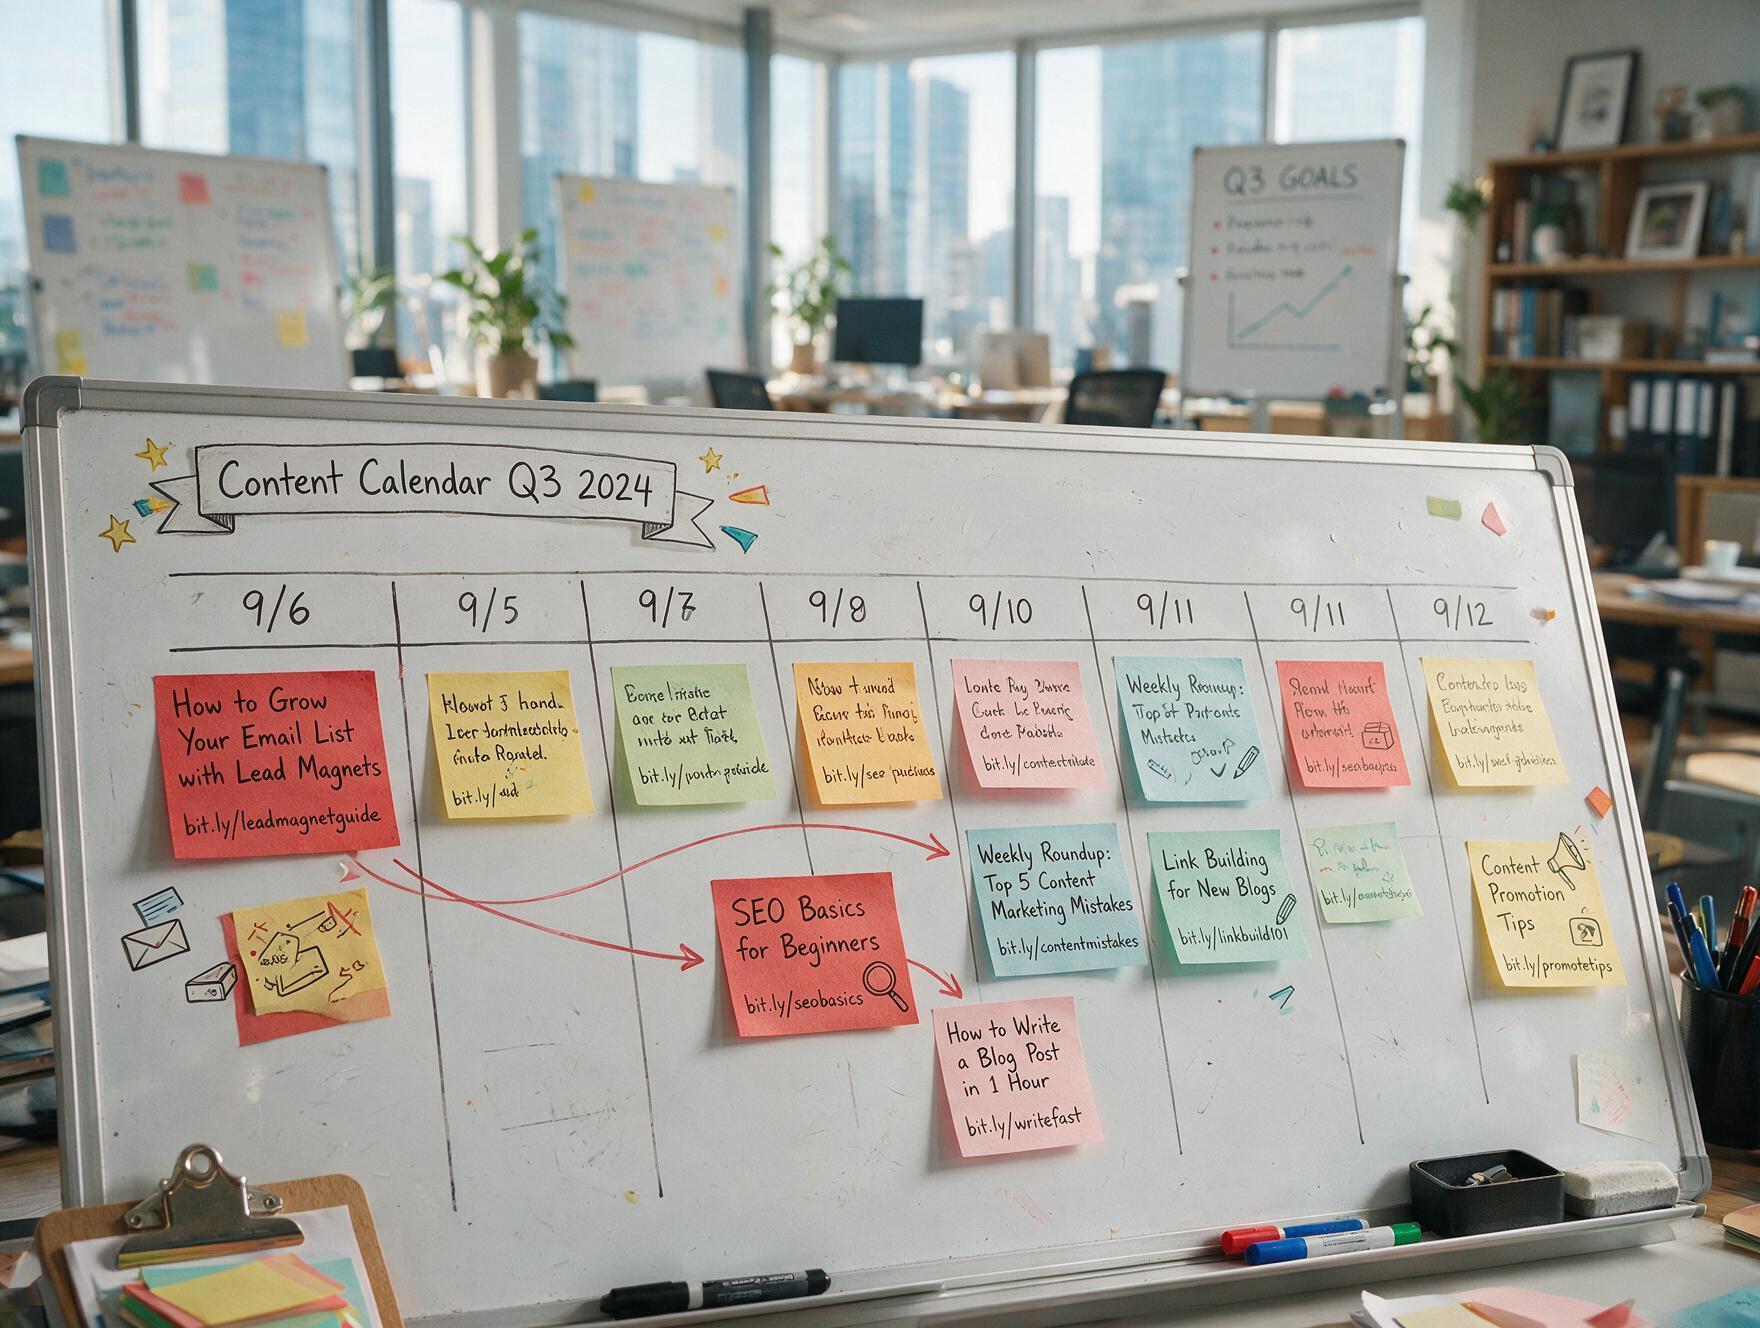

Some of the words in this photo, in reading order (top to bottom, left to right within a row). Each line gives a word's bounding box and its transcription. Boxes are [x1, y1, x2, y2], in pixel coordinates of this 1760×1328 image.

[1223, 164, 1266, 196] Q3
[1278, 163, 1358, 191] GOALS
[218, 459, 344, 499] Content
[359, 458, 491, 496] Calendar
[508, 462, 561, 504] Q3
[579, 469, 653, 507] 2024
[243, 584, 310, 633] 9/6
[458, 586, 519, 633] 9/5
[969, 590, 1033, 630] 9/10
[1137, 590, 1193, 630] 9/11
[1291, 594, 1345, 632] 9/11
[1433, 594, 1493, 630] 9/12
[172, 687, 222, 718] How
[234, 689, 257, 714] to
[268, 686, 327, 713] Grow
[1126, 673, 1181, 701] Weekly
[177, 726, 230, 756] Your
[241, 720, 302, 749] Email
[314, 719, 354, 744] List
[178, 761, 225, 788] with
[236, 756, 286, 784] Lead
[298, 754, 382, 791] Magnets
[183, 803, 382, 841] bit.ly/leadmagnetguide
[977, 842, 1033, 871] Weekly
[1040, 841, 1111, 868] Roundup:
[1162, 849, 1199, 871] Link
[1204, 847, 1269, 876] Building
[1481, 854, 1540, 876] Content
[983, 874, 1012, 897] Top
[1018, 872, 1030, 891] 5
[1038, 869, 1096, 890] Content
[1167, 879, 1190, 900] for
[1196, 878, 1230, 898] New
[1236, 876, 1276, 905] Blogs
[1488, 882, 1565, 904] Promotion
[731, 897, 785, 927] SEO
[798, 894, 866, 922] Basics
[991, 899, 1067, 926] Marketing
[1070, 893, 1134, 915] Mistakes
[1497, 912, 1535, 939] Tips
[736, 935, 769, 962] for
[780, 933, 880, 968] Beginners
[997, 932, 1139, 961] bit.ly/contentmistakes
[1178, 925, 1289, 951] bit.ly/linkbuild101
[1503, 953, 1613, 979] bit.ly/promotetips
[744, 989, 864, 1018] bit.ly/seobasics
[946, 1021, 982, 1045] How
[988, 1019, 1007, 1038] to
[1012, 1014, 1061, 1036] Write
[957, 1058, 969, 1070] a
[976, 1046, 1017, 1073] Blog
[1025, 1042, 1060, 1064] Post
[962, 1081, 980, 1097] in
[989, 1075, 999, 1094] 1
[1007, 1072, 1050, 1092] Hour
[964, 1105, 1082, 1141] bit.ly/writefast
